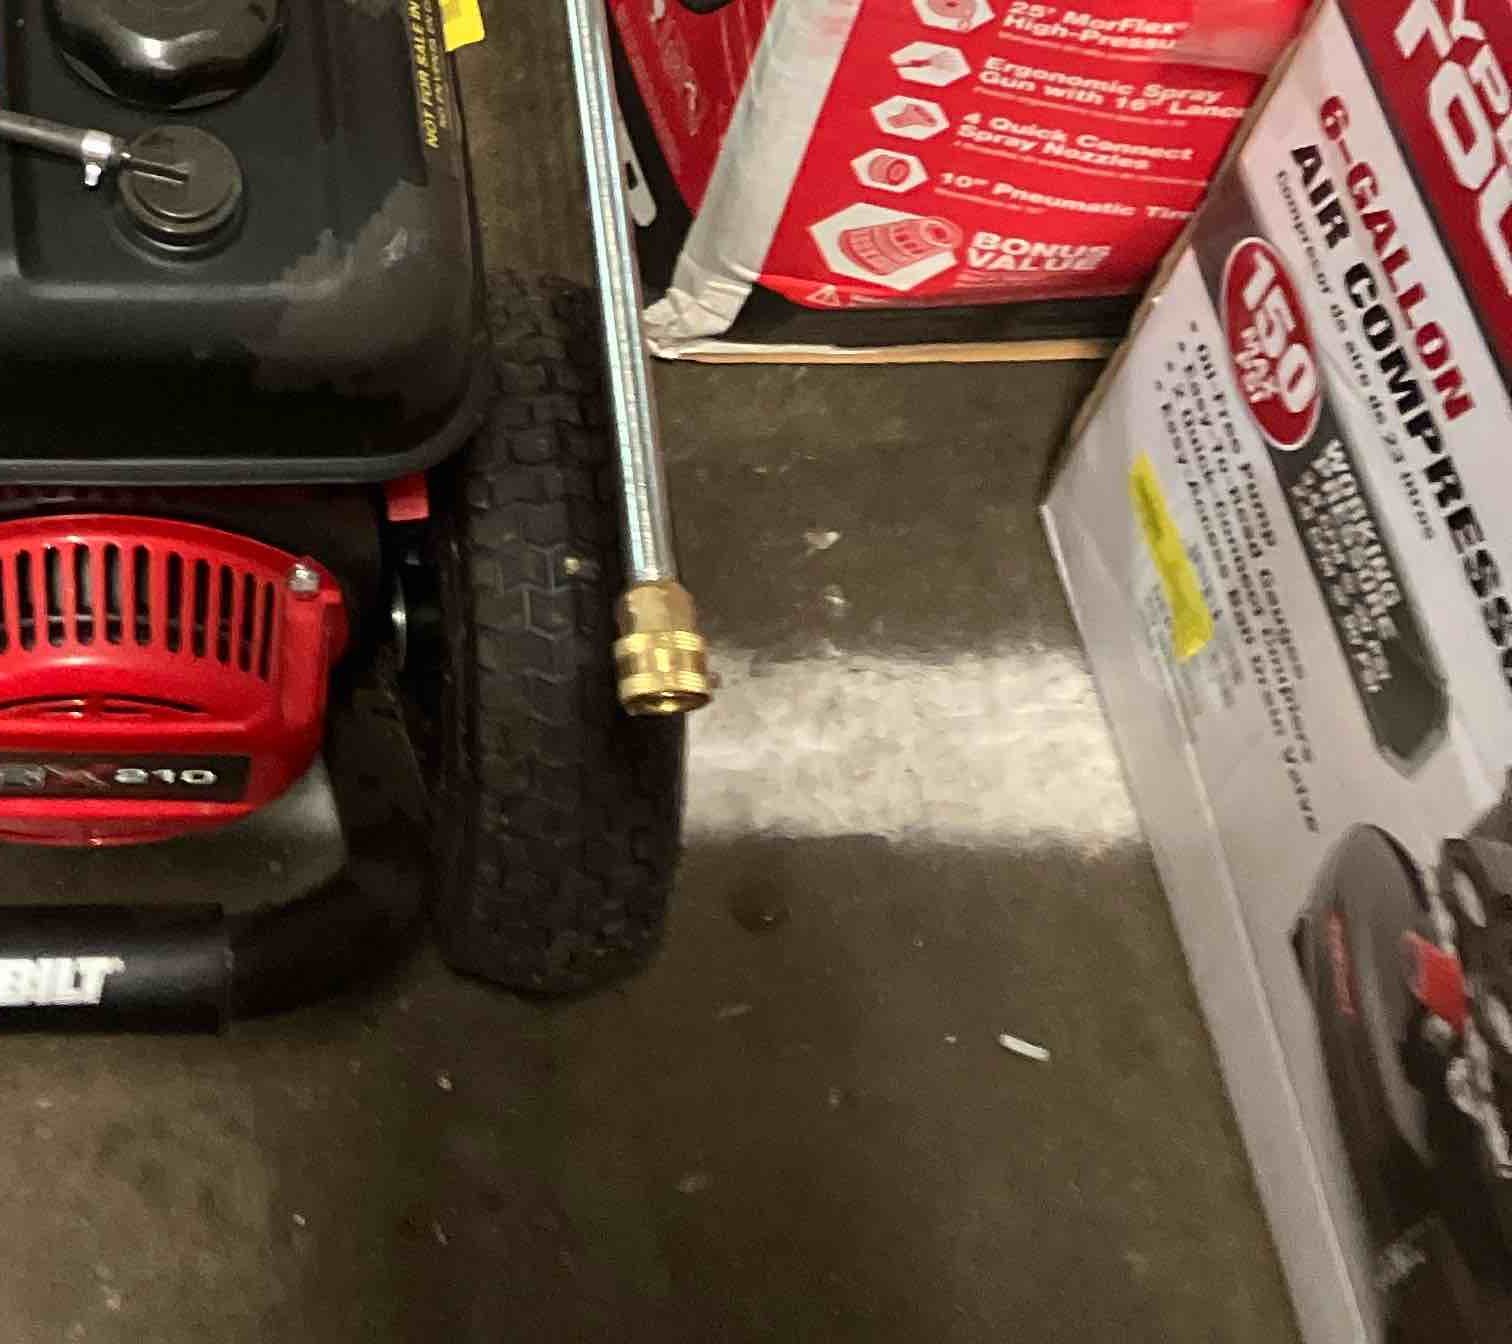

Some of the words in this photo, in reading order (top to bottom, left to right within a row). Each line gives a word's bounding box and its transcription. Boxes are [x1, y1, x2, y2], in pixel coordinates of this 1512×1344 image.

[409, 0, 421, 19] IN
[413, 23, 428, 67] SALE
[417, 70, 434, 105] FOR
[978, 70, 1036, 92] Gun
[1043, 84, 1105, 105] with
[983, 56, 1136, 97] Ergonomic
[1141, 83, 1224, 104] Spray
[424, 110, 440, 148] NOT
[956, 122, 1039, 151] Spray
[1043, 141, 1151, 170] Nozzles
[962, 112, 983, 125] 4
[988, 116, 1068, 143] Quick
[1075, 134, 1194, 161] Connect
[992, 181, 1137, 217] Pneumatic
[966, 246, 1100, 272] VALUE
[971, 230, 1113, 258] BONUS
[1320, 95, 1475, 422] 6-GALLON
[1242, 250, 1318, 414] 150
[1289, 139, 1356, 249] AIR
[1343, 260, 1512, 692] COMPRESS
[114, 768, 218, 784] 210
